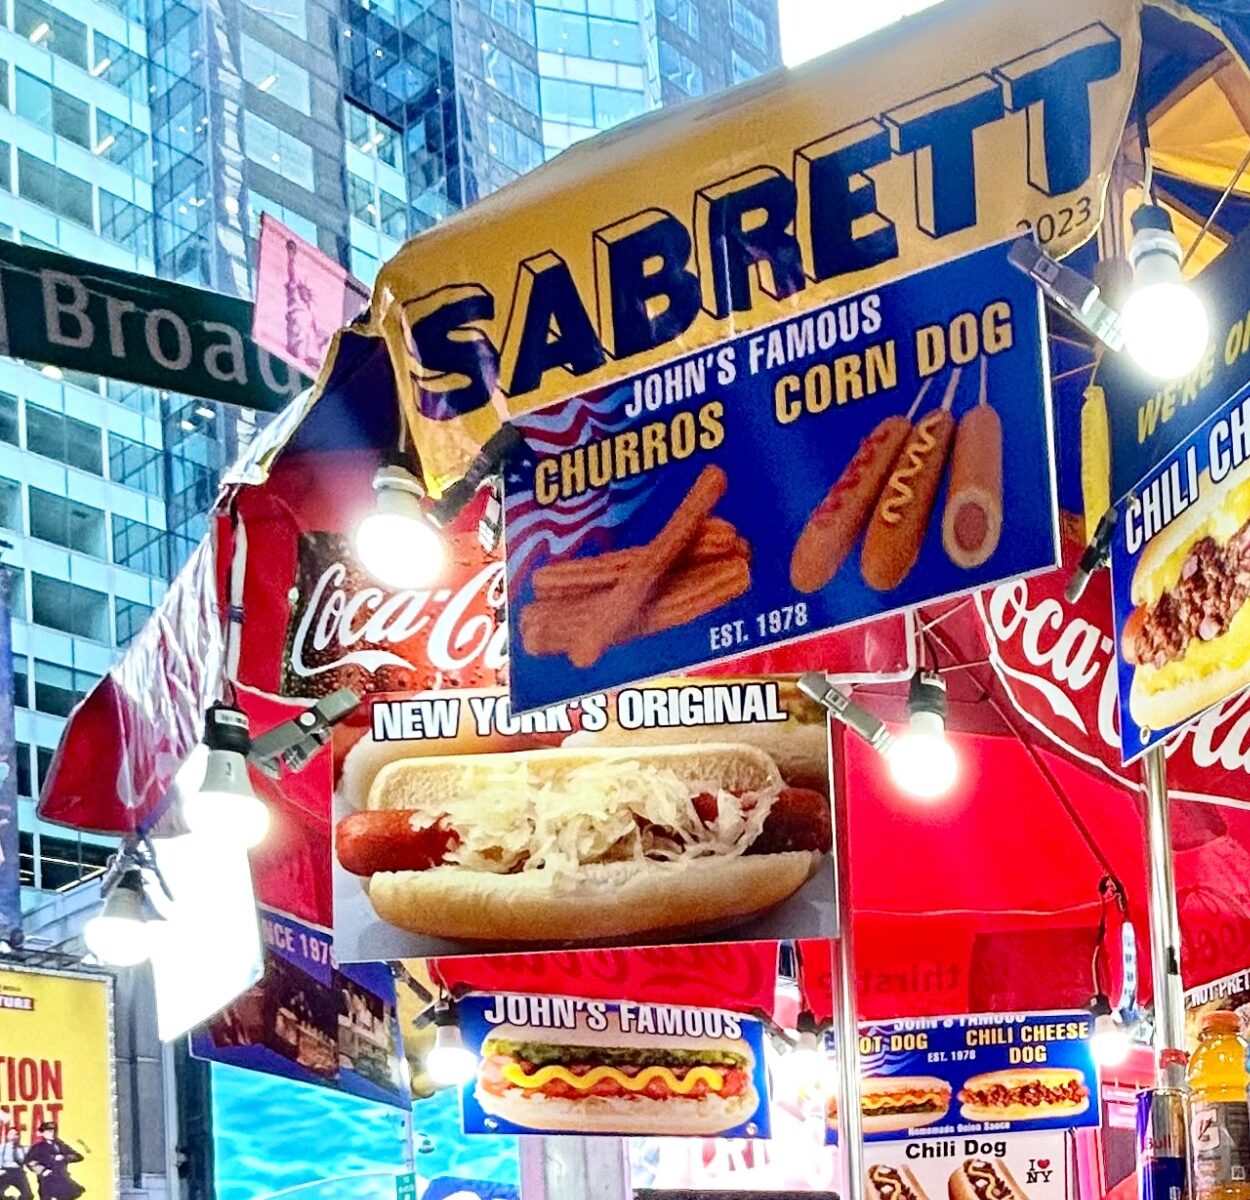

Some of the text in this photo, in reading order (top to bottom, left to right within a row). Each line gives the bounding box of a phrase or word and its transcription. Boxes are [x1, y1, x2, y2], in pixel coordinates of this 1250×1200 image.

[402, 20, 1122, 421] SABRETT
[625, 295, 883, 419] JOHN'S FAMOUS
[534, 301, 1014, 507] CHURROS CORN DOG
[1124, 453, 1200, 555] CHILI
[709, 602, 809, 652] EST. 1978
[371, 697, 461, 742] NEW
[617, 682, 788, 731] ORIGINAL
[484, 996, 743, 1040] JOHN'S FAMOUS
[890, 1021, 1090, 1050] DOG CHILI CHEESE
[0, 1055, 63, 1102] ION
[928, 1053, 948, 1063] EST.
[1008, 1045, 1048, 1065] DOG
[905, 1139, 1007, 1160] Chili Dog
[1025, 1170, 1054, 1184] NY
